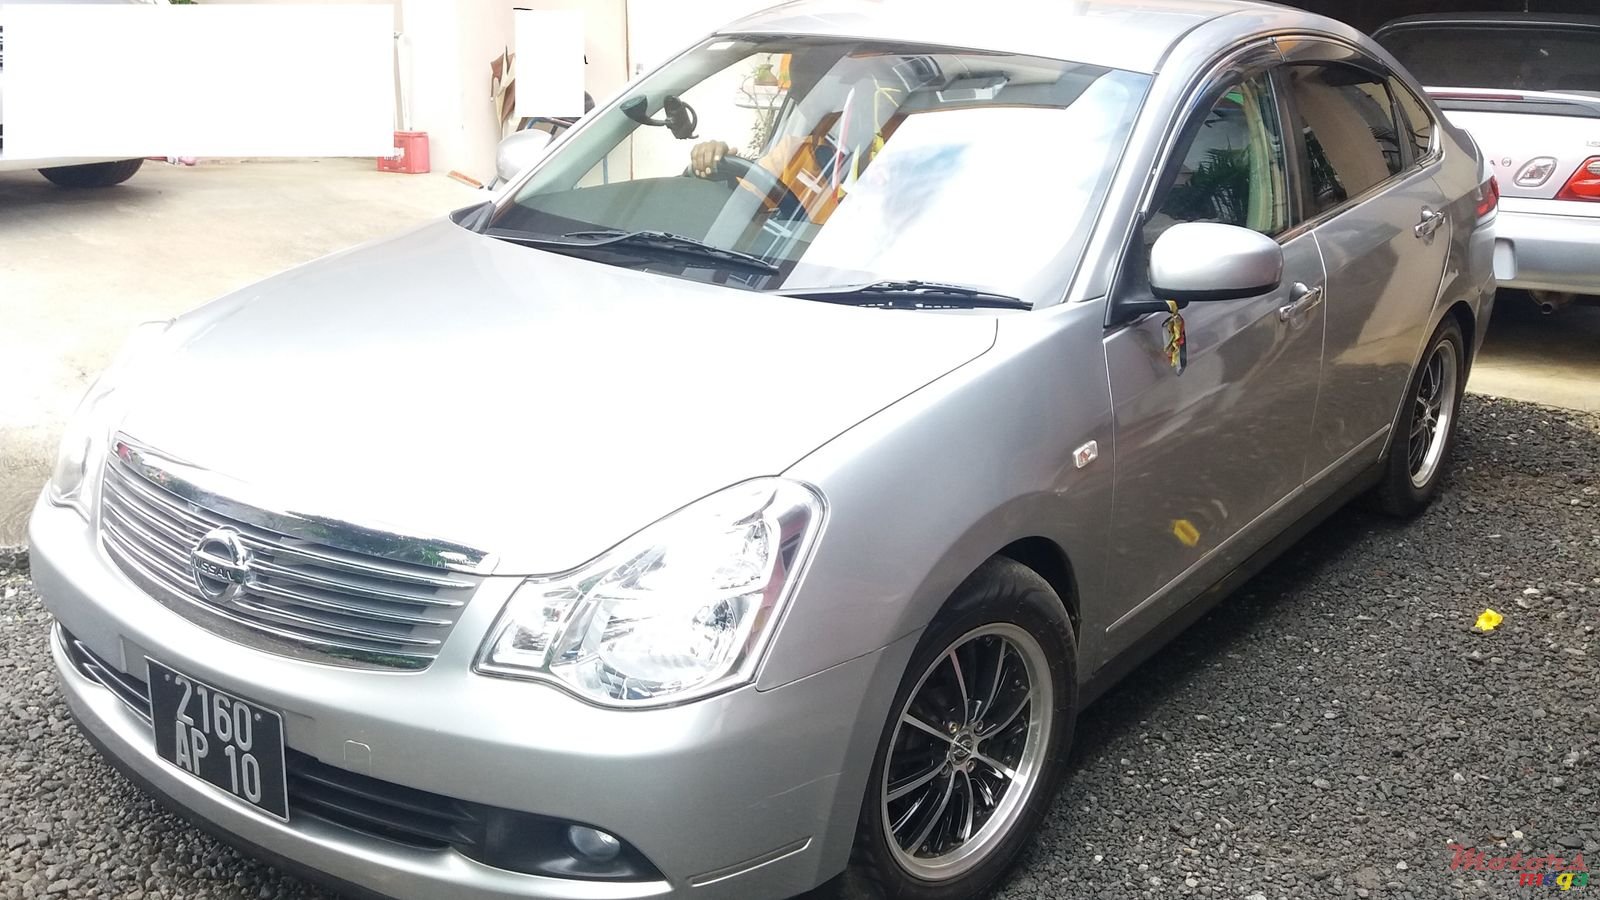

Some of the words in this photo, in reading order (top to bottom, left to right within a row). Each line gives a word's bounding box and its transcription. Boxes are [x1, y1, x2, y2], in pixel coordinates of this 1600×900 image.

[191, 554, 235, 582] NISSAN
[175, 674, 252, 751] 2160
[176, 719, 208, 775] AP
[225, 744, 261, 803] 10
